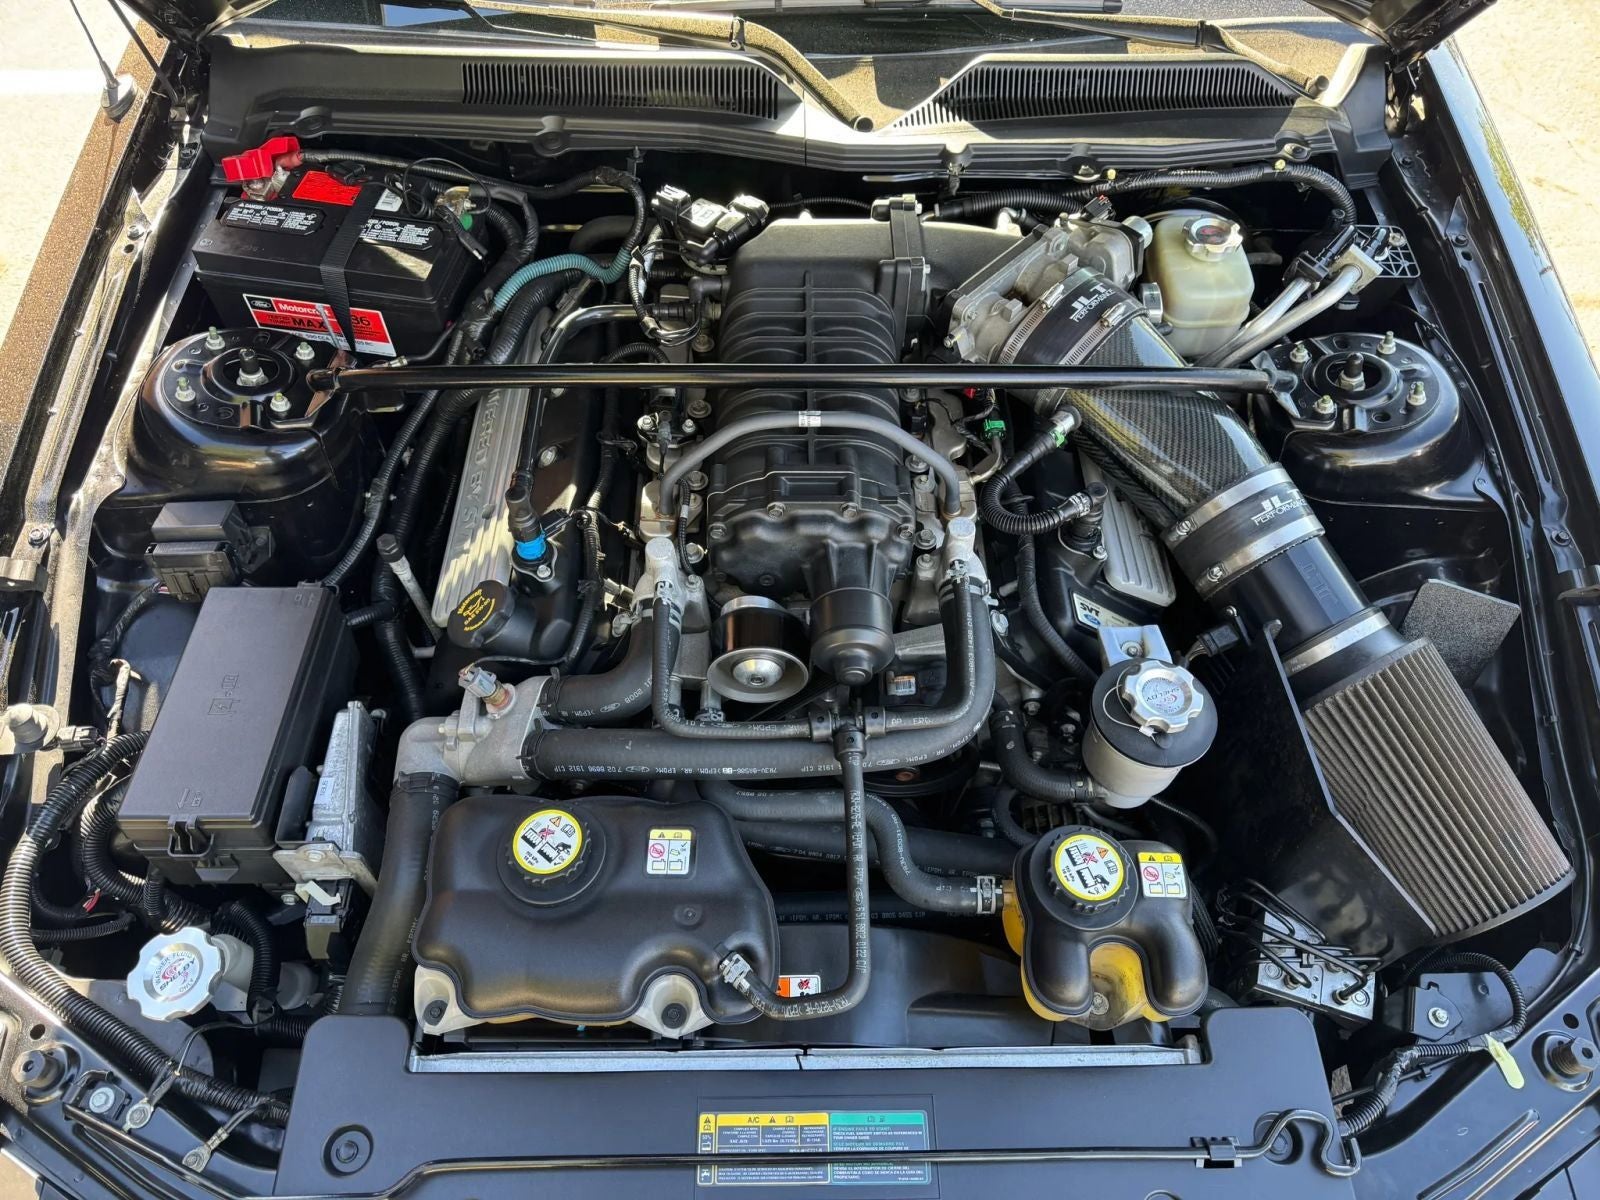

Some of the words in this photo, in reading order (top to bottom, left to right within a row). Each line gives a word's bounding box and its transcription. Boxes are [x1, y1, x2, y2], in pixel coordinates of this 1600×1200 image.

[278, 303, 331, 316] Motorcrt
[1070, 283, 1107, 317] JLT
[1072, 288, 1116, 322] PERFORMANCE
[475, 389, 500, 465] WERED
[1252, 489, 1301, 518] JLT
[1080, 602, 1101, 617] SVT
[159, 959, 196, 991] SHELBY
